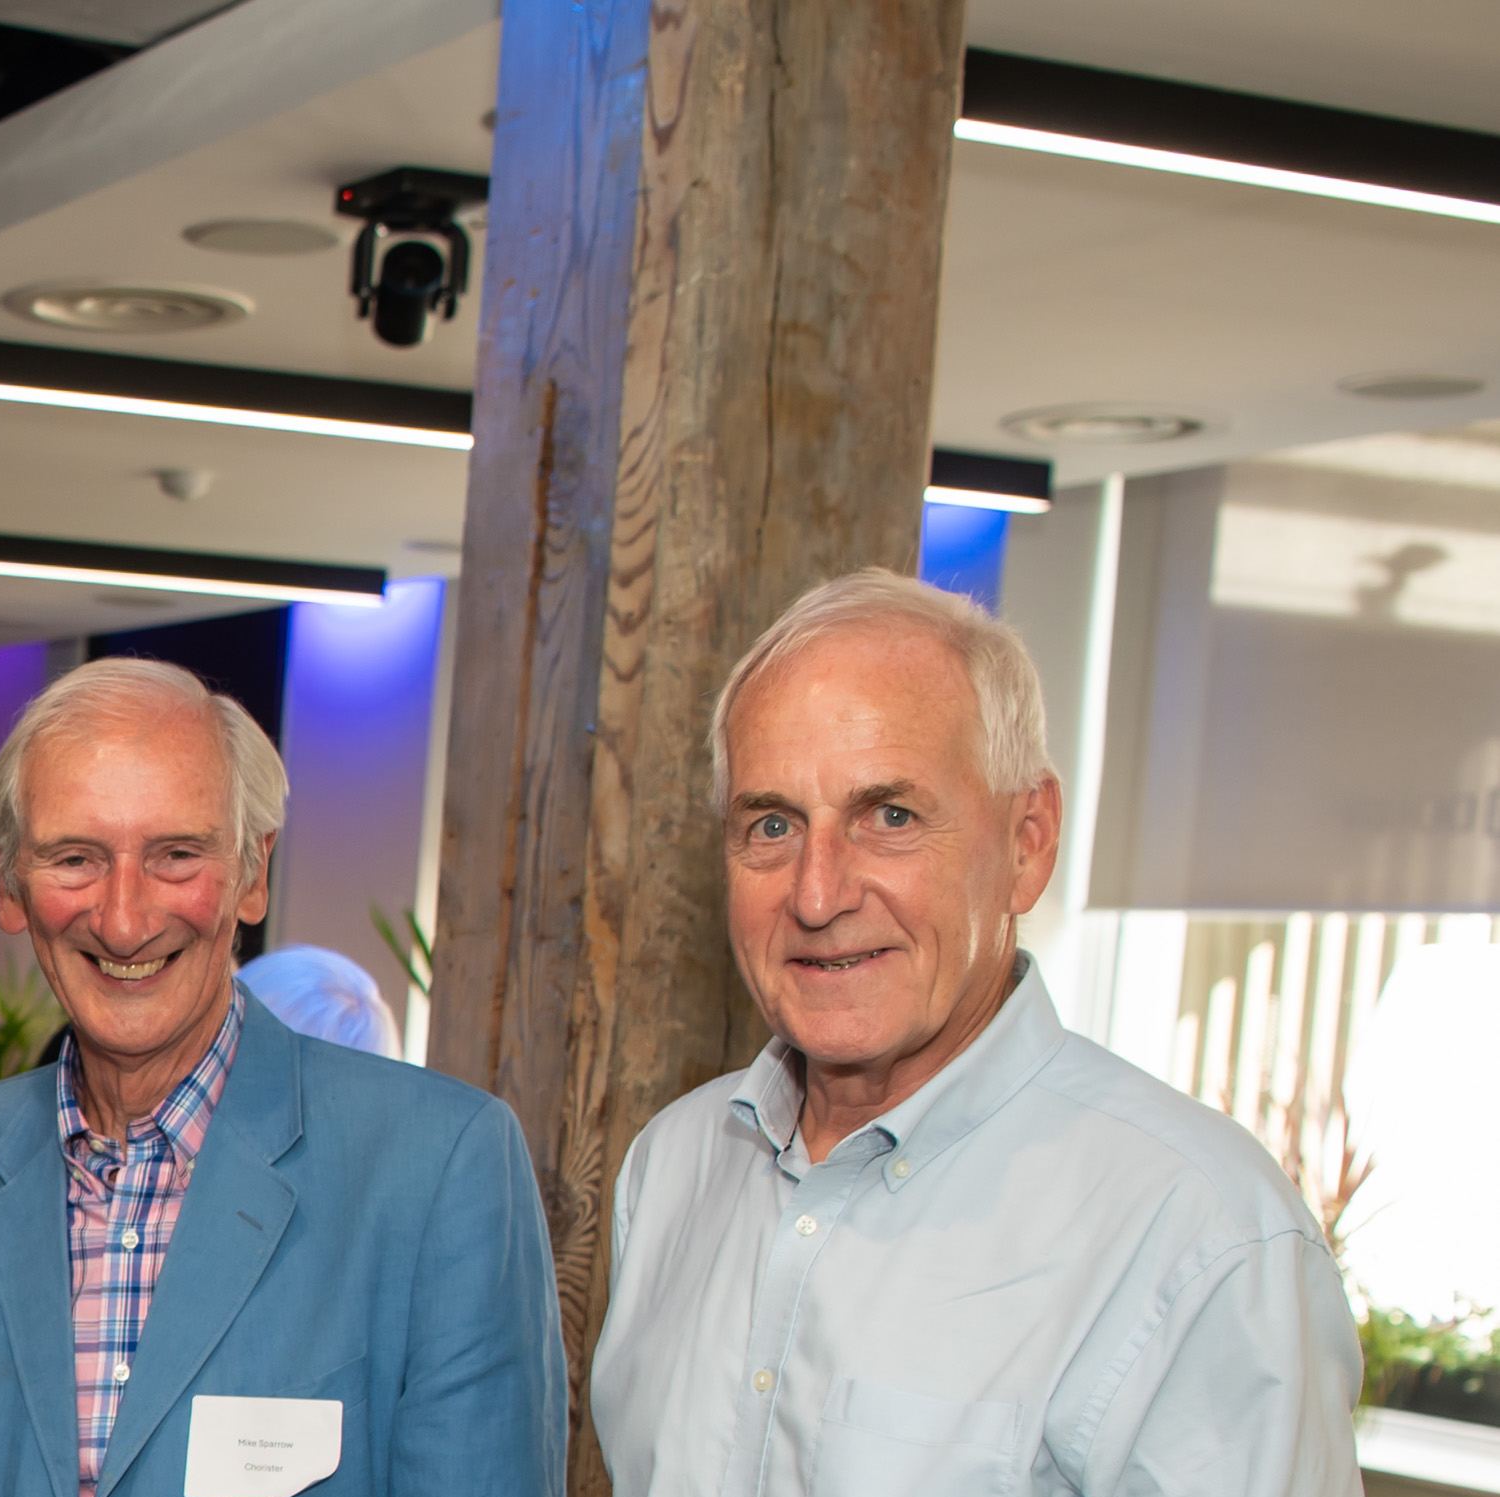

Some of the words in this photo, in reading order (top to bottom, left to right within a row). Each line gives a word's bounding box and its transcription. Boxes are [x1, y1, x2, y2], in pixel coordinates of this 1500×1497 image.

[238, 1438, 257, 1447] Mike
[258, 1439, 294, 1450] Sparrow
[244, 1462, 284, 1472] Chorister
